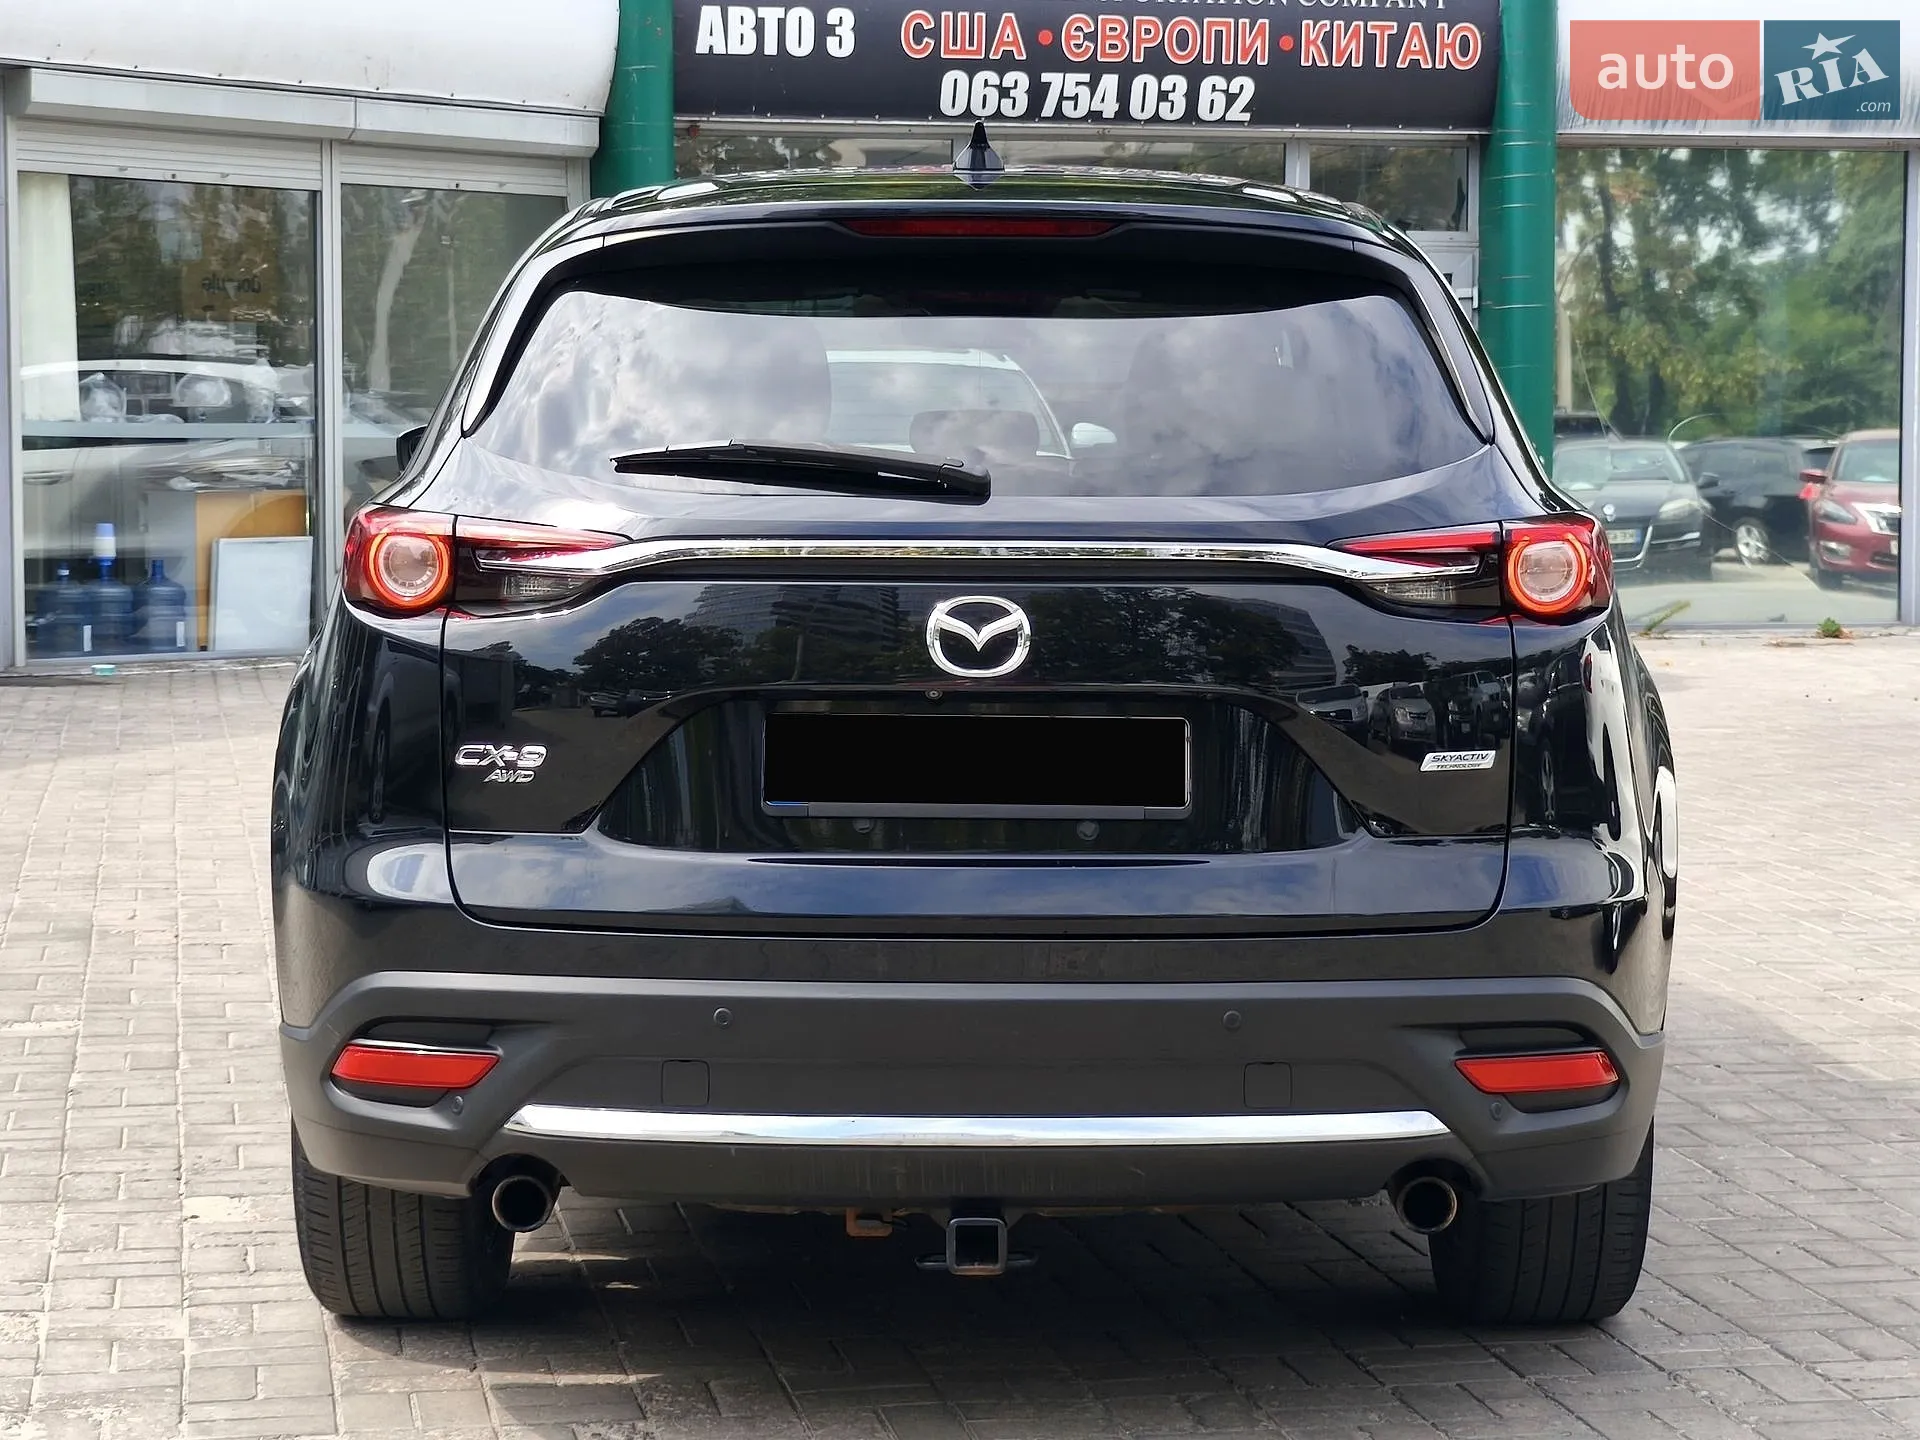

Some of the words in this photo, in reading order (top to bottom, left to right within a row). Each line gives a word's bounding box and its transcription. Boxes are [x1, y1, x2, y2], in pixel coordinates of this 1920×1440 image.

[695, 5, 816, 57] АВТО
[901, 9, 1027, 60] США
[1061, 13, 1270, 66] ЄВРОПИ
[1300, 19, 1482, 70] КИТАЮ
[939, 69, 1030, 118] 063
[1040, 72, 1119, 119] 754
[1129, 73, 1188, 121] 03
[1197, 75, 1256, 122] 62
[454, 744, 548, 768] CX-9
[1431, 753, 1489, 762] SKYACTIV
[482, 768, 536, 783] AWD
